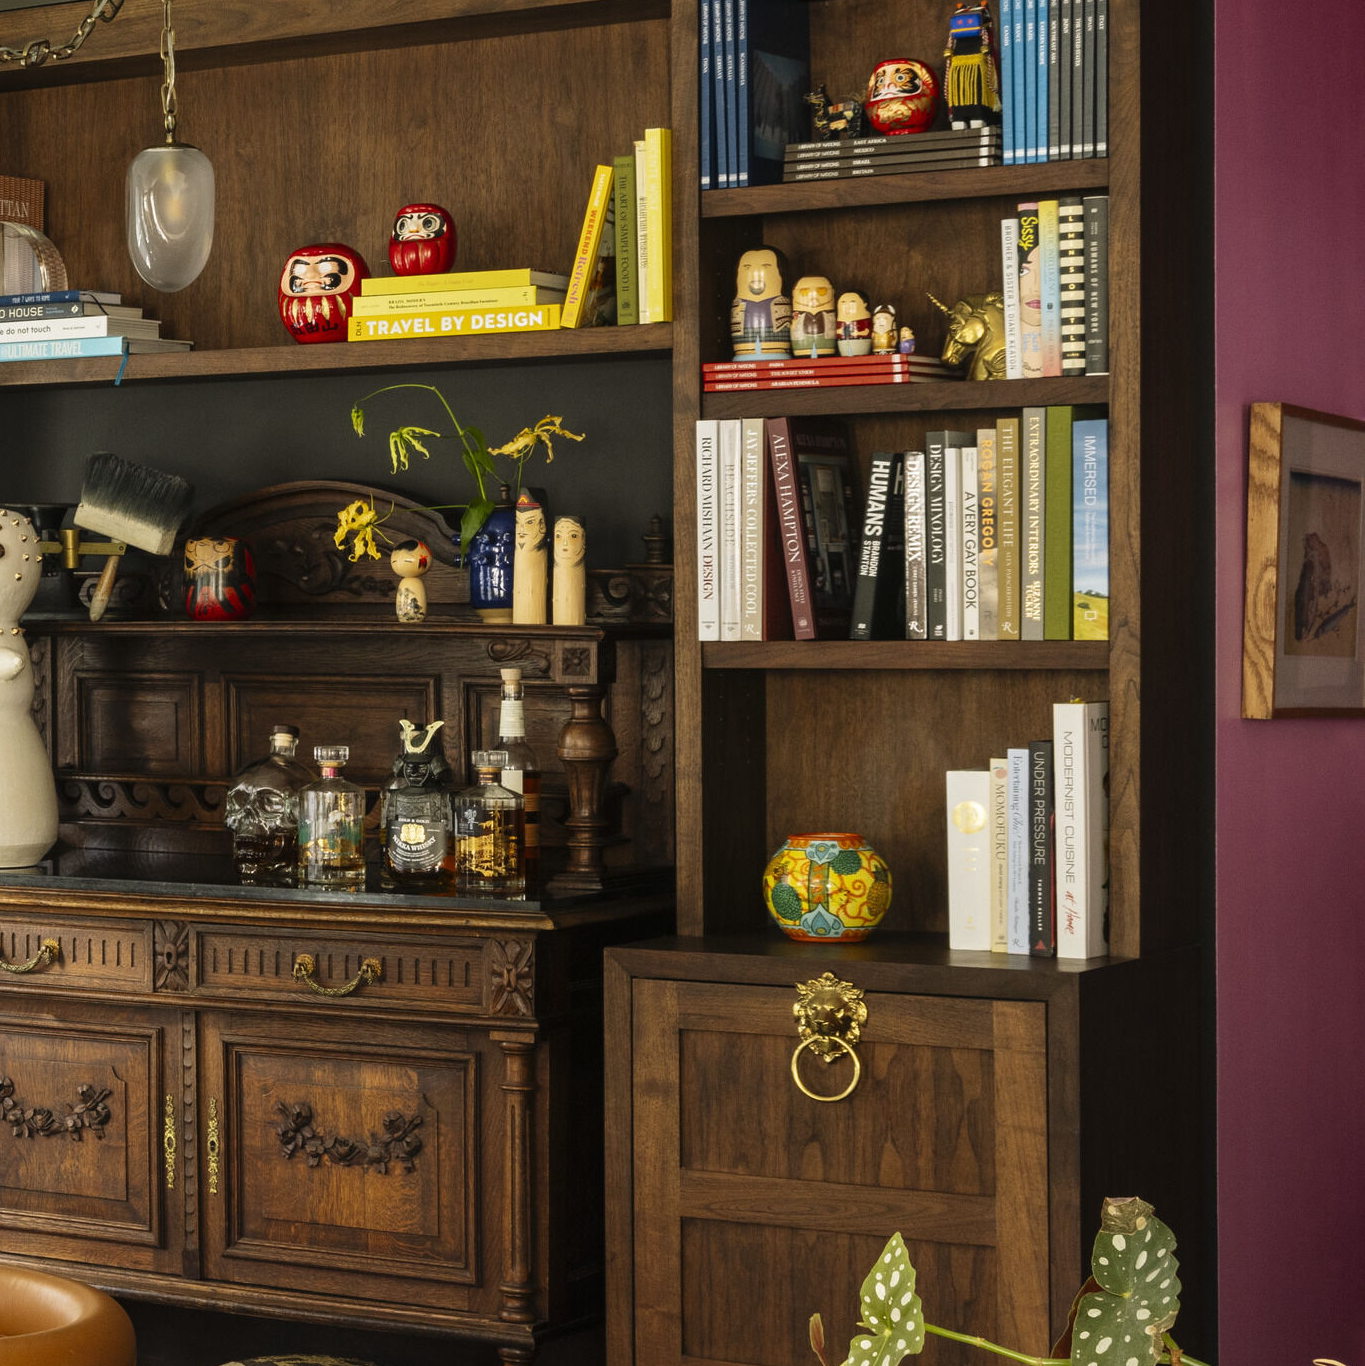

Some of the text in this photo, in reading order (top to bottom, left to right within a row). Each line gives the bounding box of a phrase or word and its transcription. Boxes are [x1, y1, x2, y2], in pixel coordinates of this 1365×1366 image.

[619, 176, 627, 189] THE
[567, 209, 597, 305] WEEKEND Refresh
[620, 224, 628, 254] SIMPLE
[1005, 226, 1014, 261] BROTHER
[1019, 216, 1038, 250] Sissy
[621, 258, 629, 282] FOOD
[1006, 273, 1014, 299] SISTER
[1090, 278, 1097, 287] OF
[9, 307, 43, 317] HOUSE
[366, 311, 543, 335] TRAVEL BY DESIGN
[9, 340, 83, 358] ULTIMATE TRAVEL
[773, 434, 800, 562] ALEXA HAMPTON
[864, 461, 890, 536] HUMANS
[1002, 426, 1013, 547] THE ELEGANT LIFE
[1029, 417, 1040, 575] EXTRAORDINARY INTERIORS
[1084, 436, 1096, 506] IMMERSED
[702, 437, 713, 600] RICHARD MISHAAN DESIGN
[724, 464, 735, 547] BEACHSIDE
[746, 430, 758, 617] JAY JEFFERS COLLECTED COOL
[906, 460, 921, 562] DESIGN REMIX
[930, 444, 943, 565] DESIGN MIXOLOGY
[981, 440, 994, 567] ROGAN GREGORY
[859, 541, 871, 575] STANTON
[868, 541, 881, 577] BRANDON
[965, 492, 976, 609] A VERY GAY BOOK
[1033, 580, 1041, 621] SUZANNE
[1011, 756, 1023, 810] Entertaining
[1063, 731, 1075, 819] MODERNIST
[995, 784, 1005, 860] MOMOFUKU
[1034, 752, 1045, 865] UNDER PRESSURE
[393, 834, 436, 851] NIKKA WHISKY
[1065, 826, 1075, 883] CUISINE
